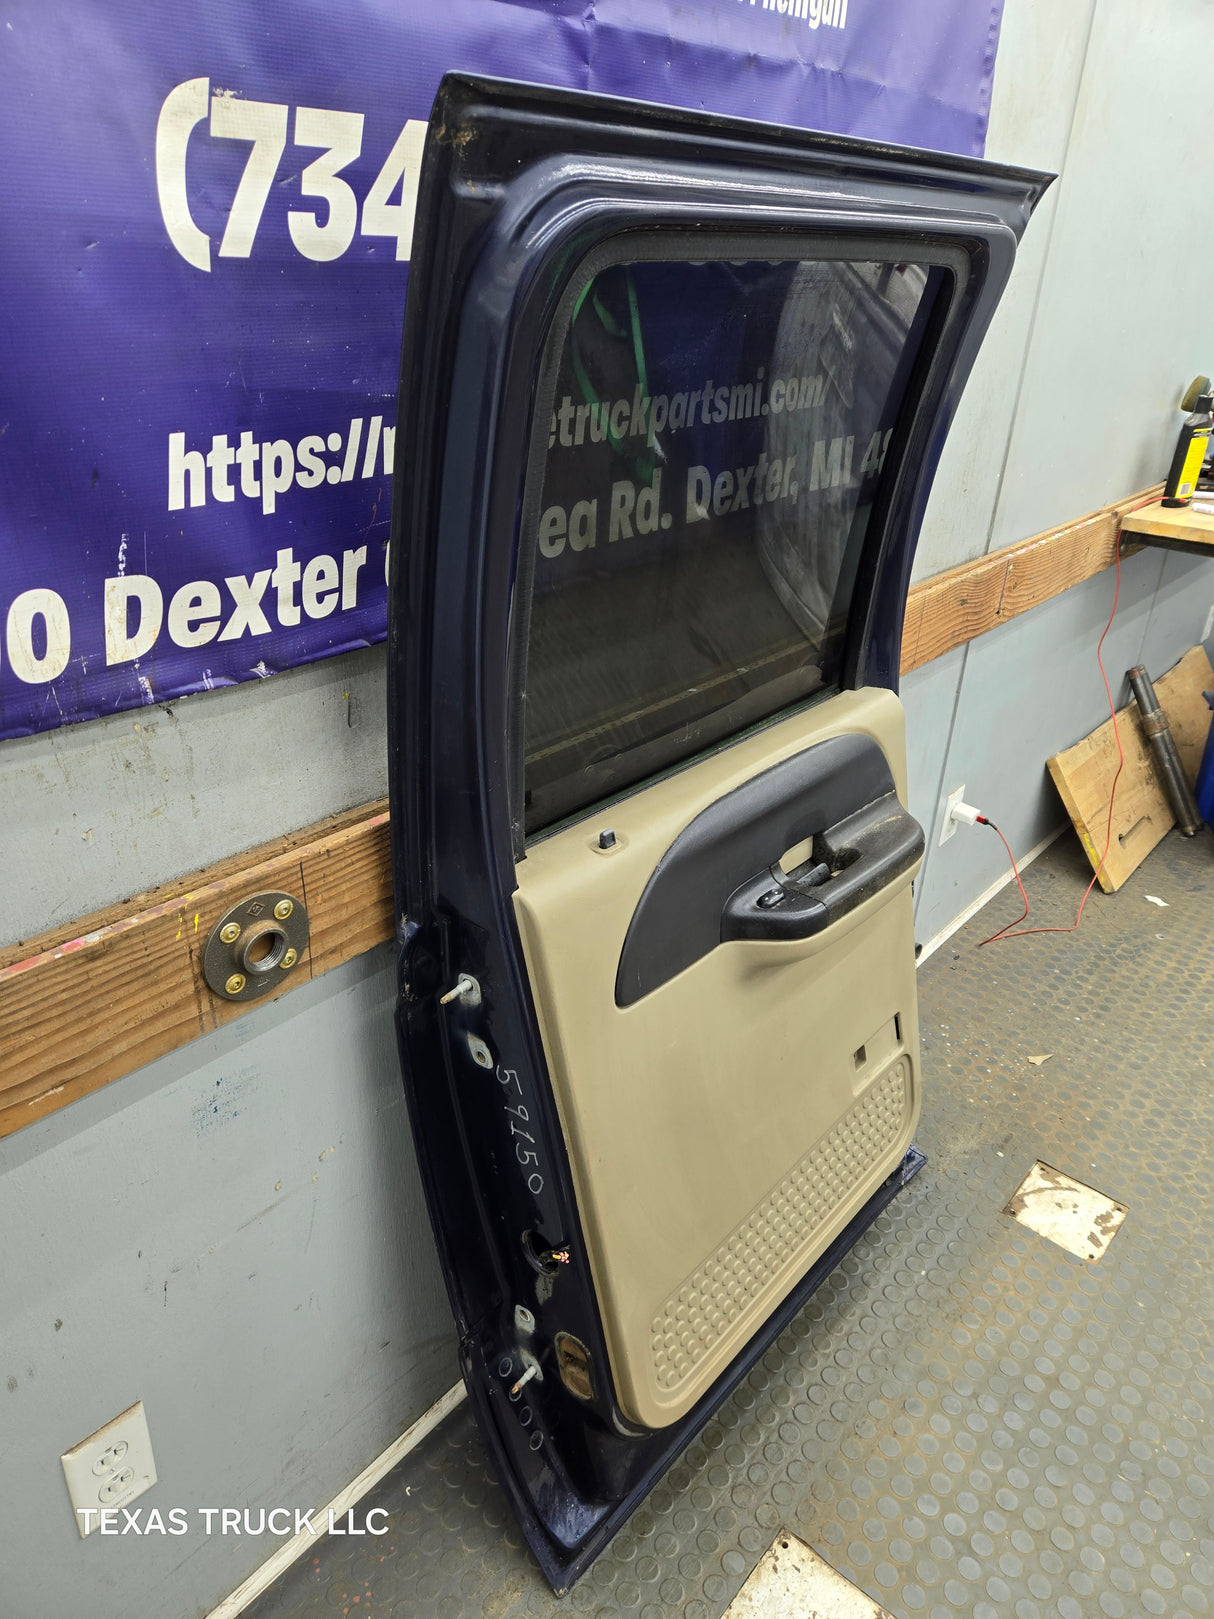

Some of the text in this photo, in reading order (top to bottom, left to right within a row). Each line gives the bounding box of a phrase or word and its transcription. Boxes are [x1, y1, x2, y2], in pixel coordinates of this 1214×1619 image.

[155, 76, 429, 273] (734
[548, 366, 837, 450] truckpartsmi.com/
[104, 545, 368, 667] Dexter
[609, 466, 673, 543] Rd.
[685, 452, 800, 524] Dexter,
[809, 435, 855, 492] MI
